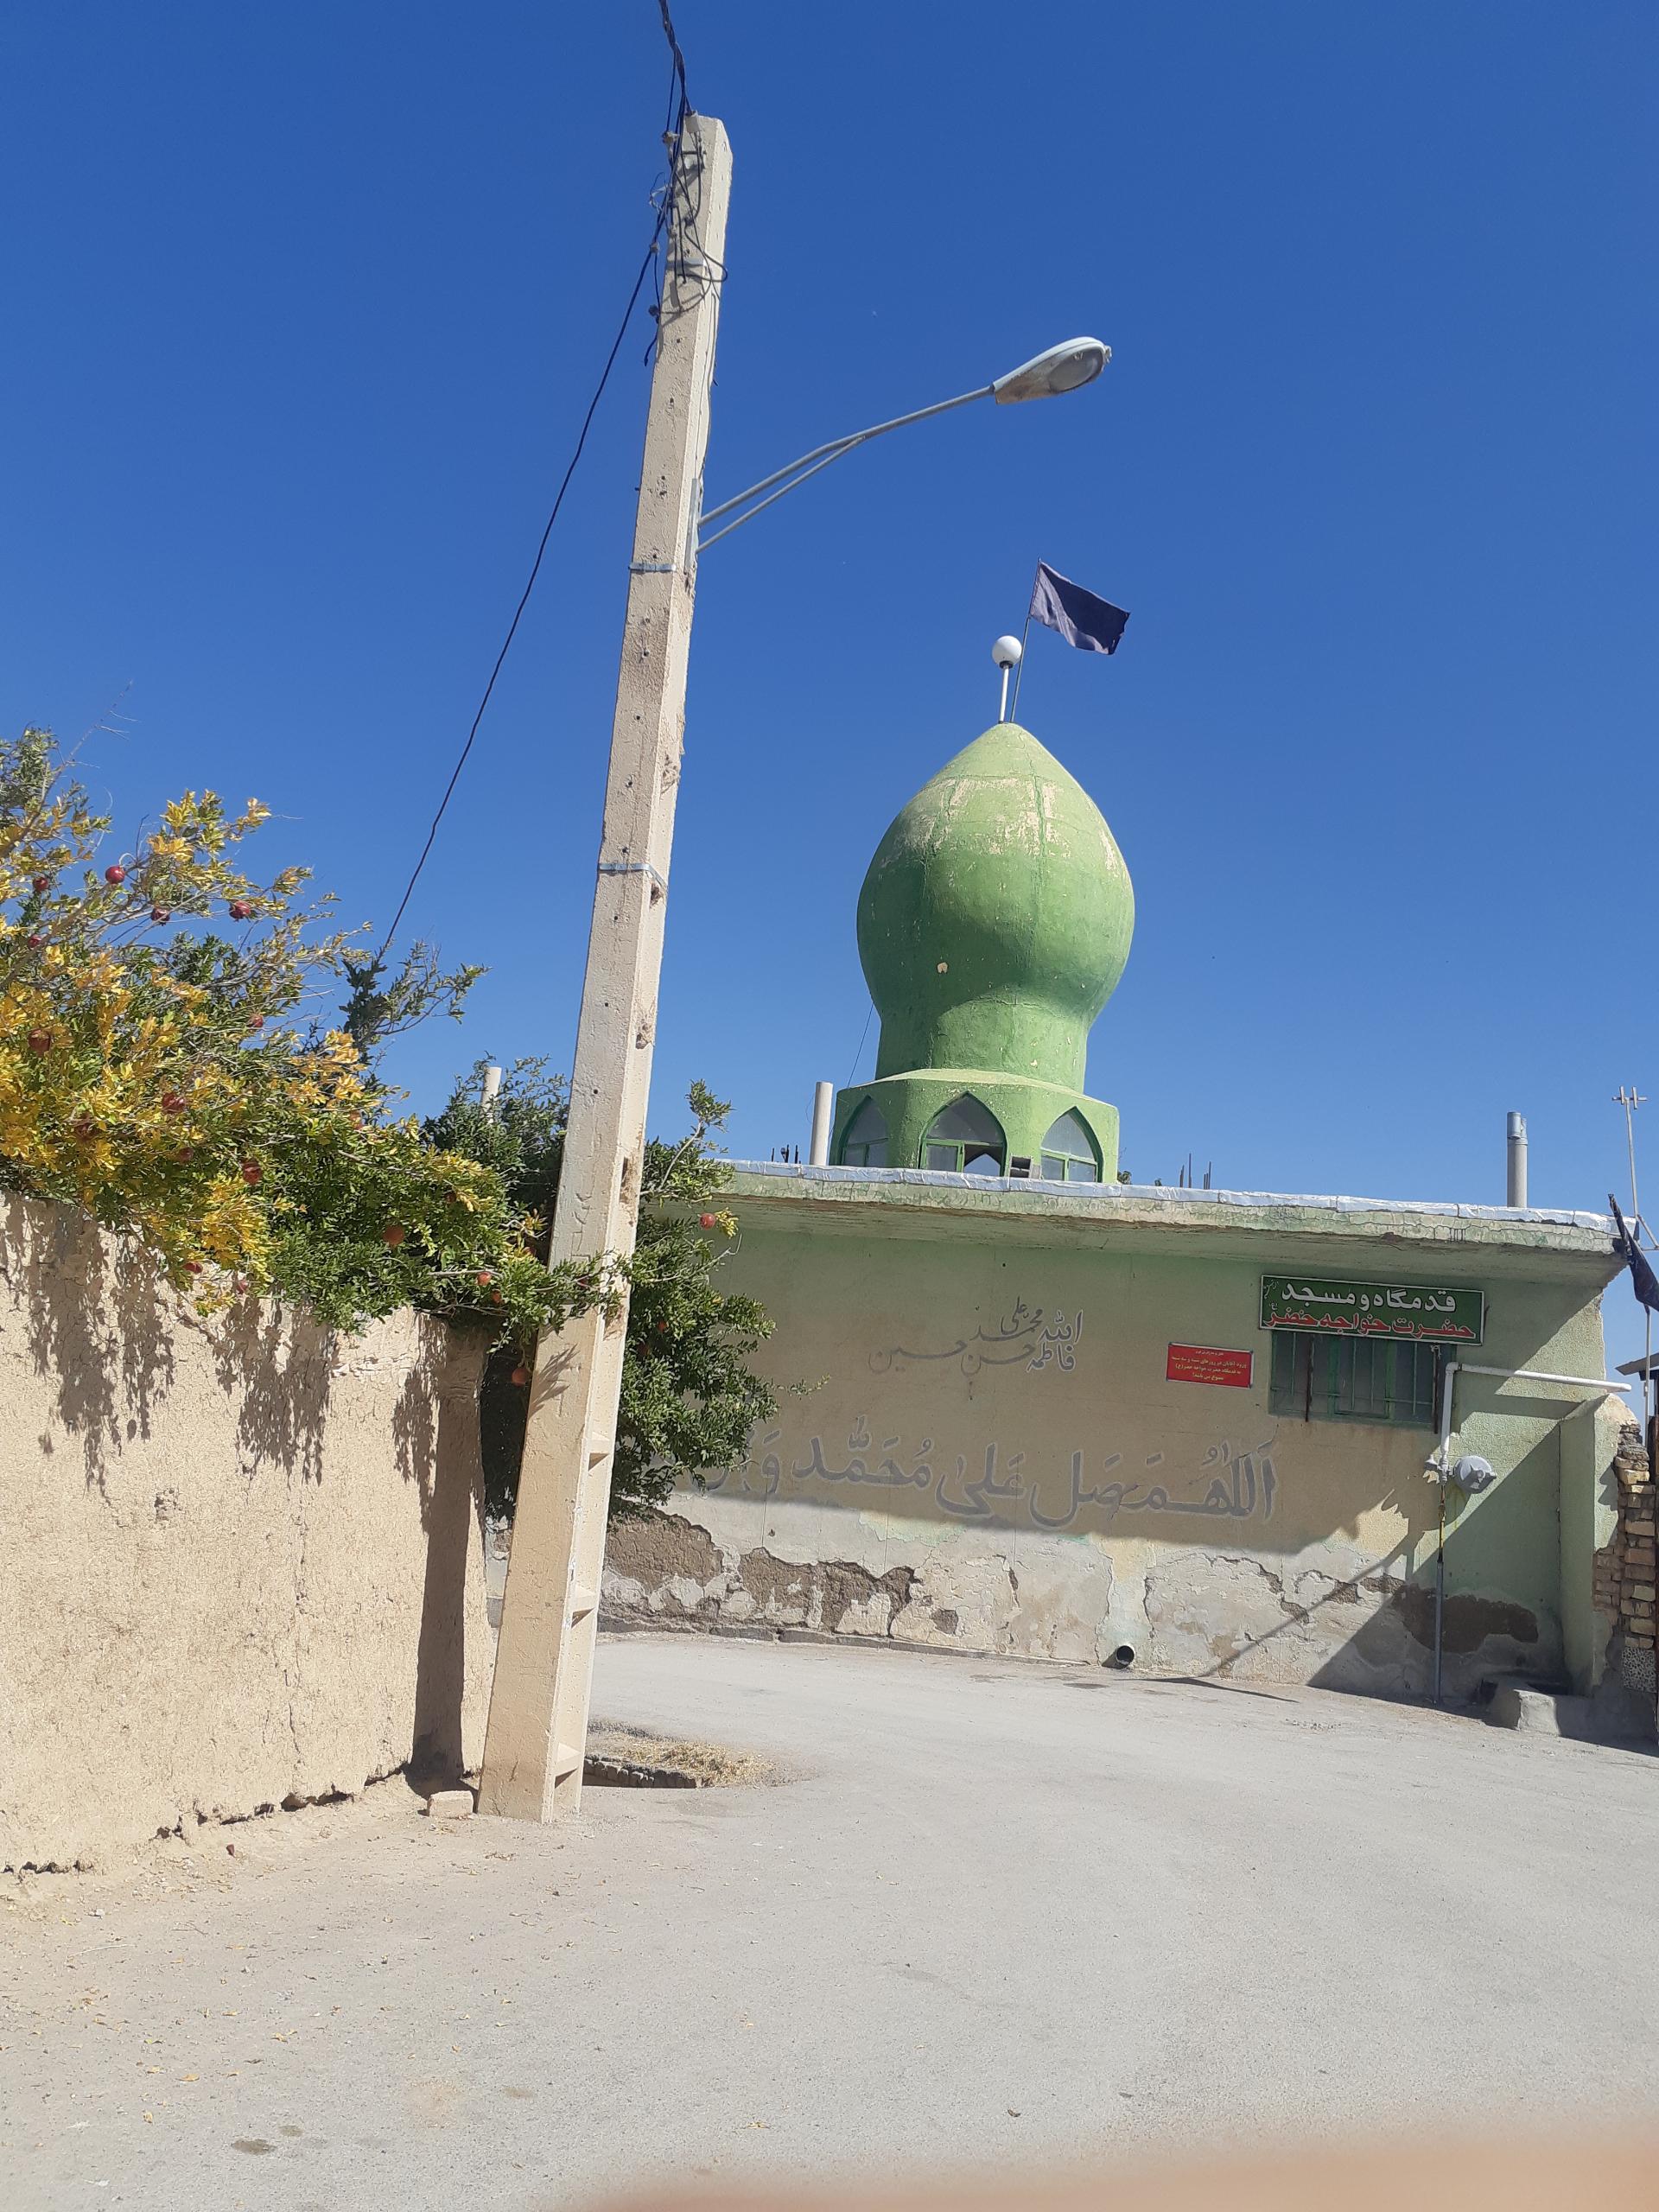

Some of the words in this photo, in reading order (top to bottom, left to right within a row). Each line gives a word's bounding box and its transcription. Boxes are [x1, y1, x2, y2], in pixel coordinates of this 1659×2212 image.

[1281, 1282, 1357, 1307] مسجد
[1357, 1294, 1370, 1312] و
[1373, 1288, 1457, 1313] قدمگاه
[1319, 1312, 1391, 1334] خواجه
[1392, 1317, 1477, 1338] حضرت
